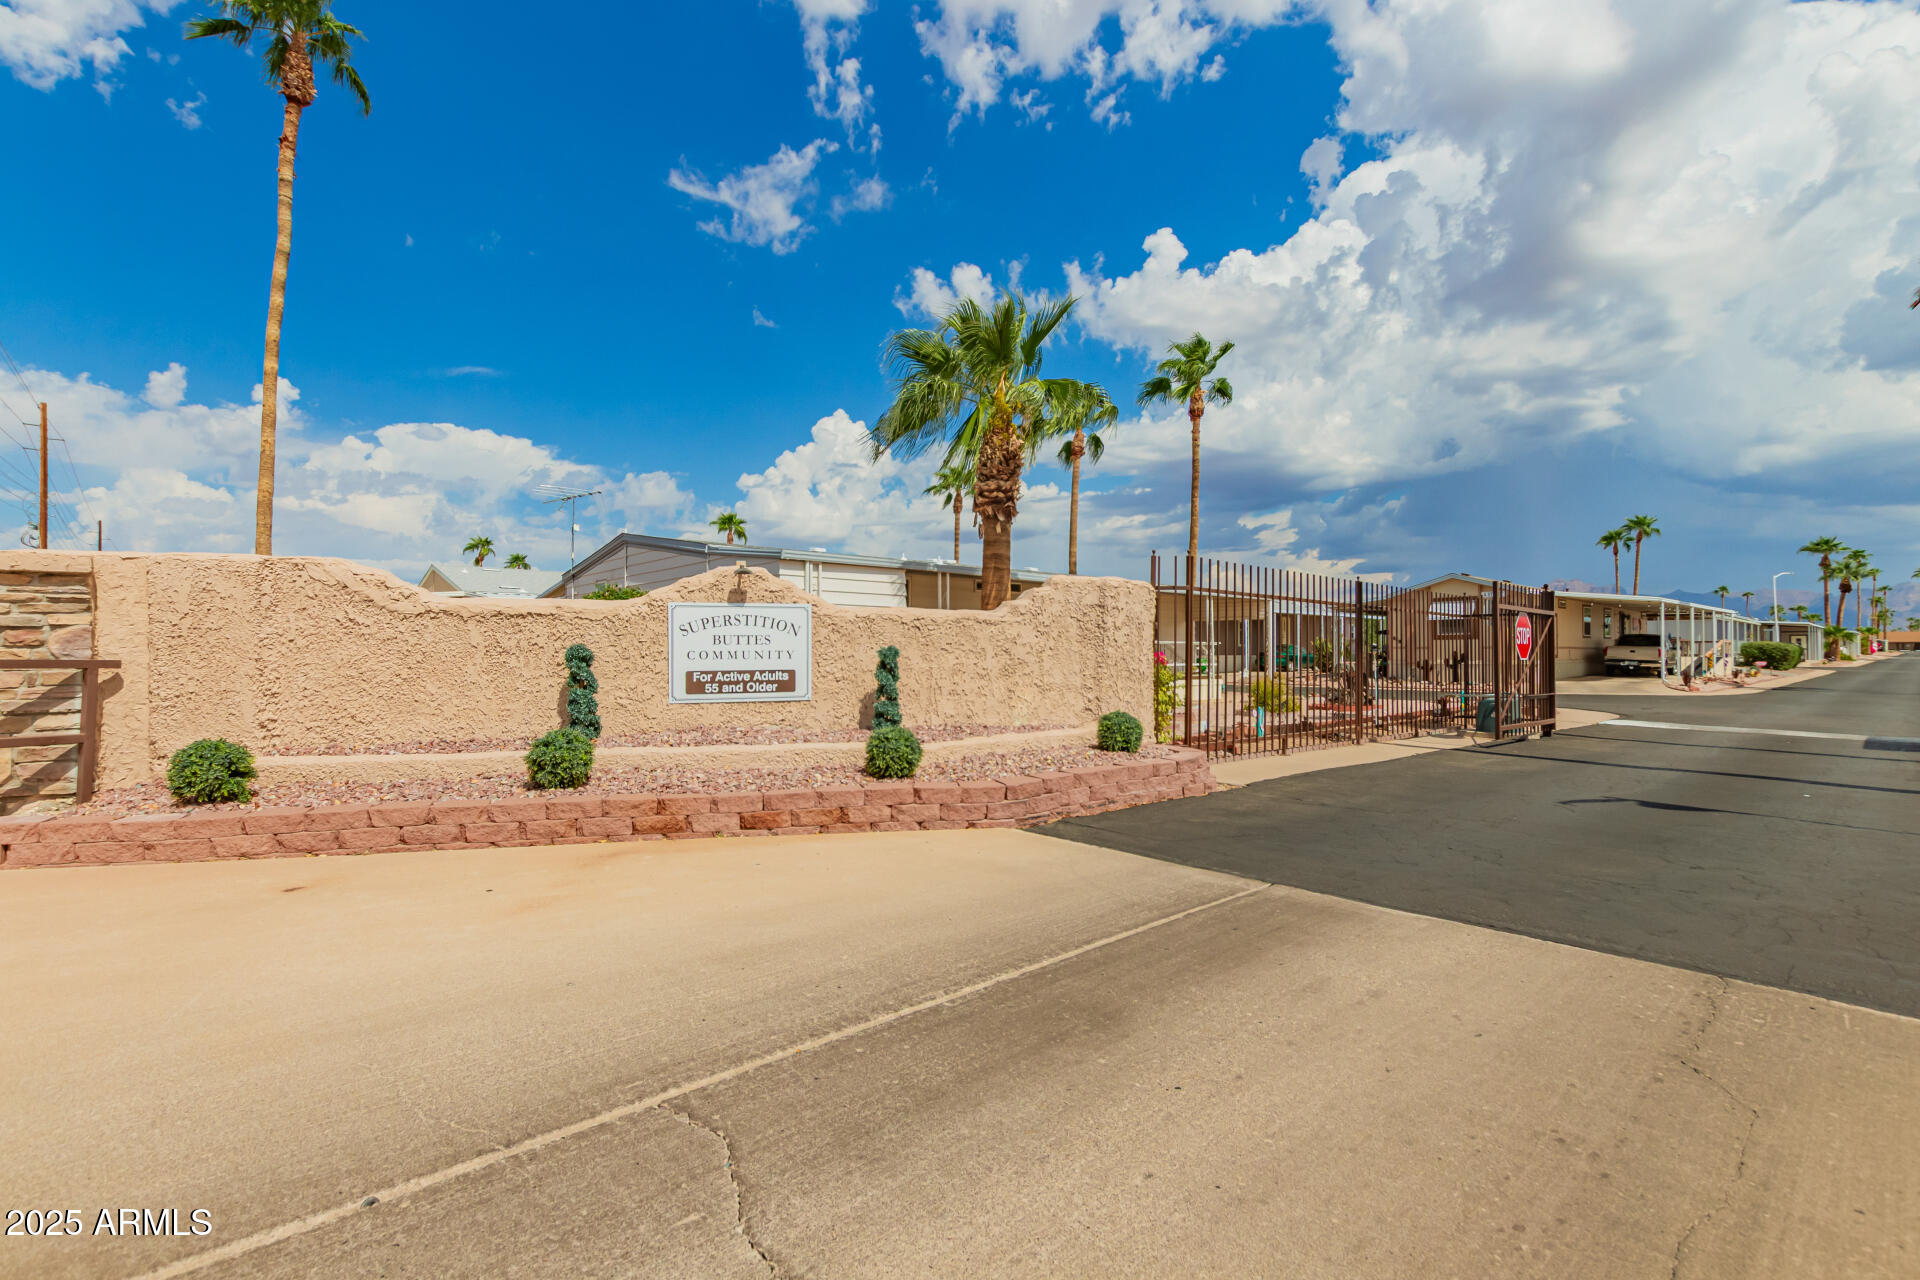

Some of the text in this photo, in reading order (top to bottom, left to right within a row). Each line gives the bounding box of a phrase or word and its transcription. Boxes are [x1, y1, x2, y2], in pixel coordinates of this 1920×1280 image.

[679, 614, 800, 637] SUPERSTITION
[712, 635, 771, 645] BUTTES
[1517, 627, 1530, 645] STOP
[686, 650, 794, 660] COMMUNITY
[693, 671, 789, 682] For Active Adults
[705, 682, 778, 693] 55 and Older
